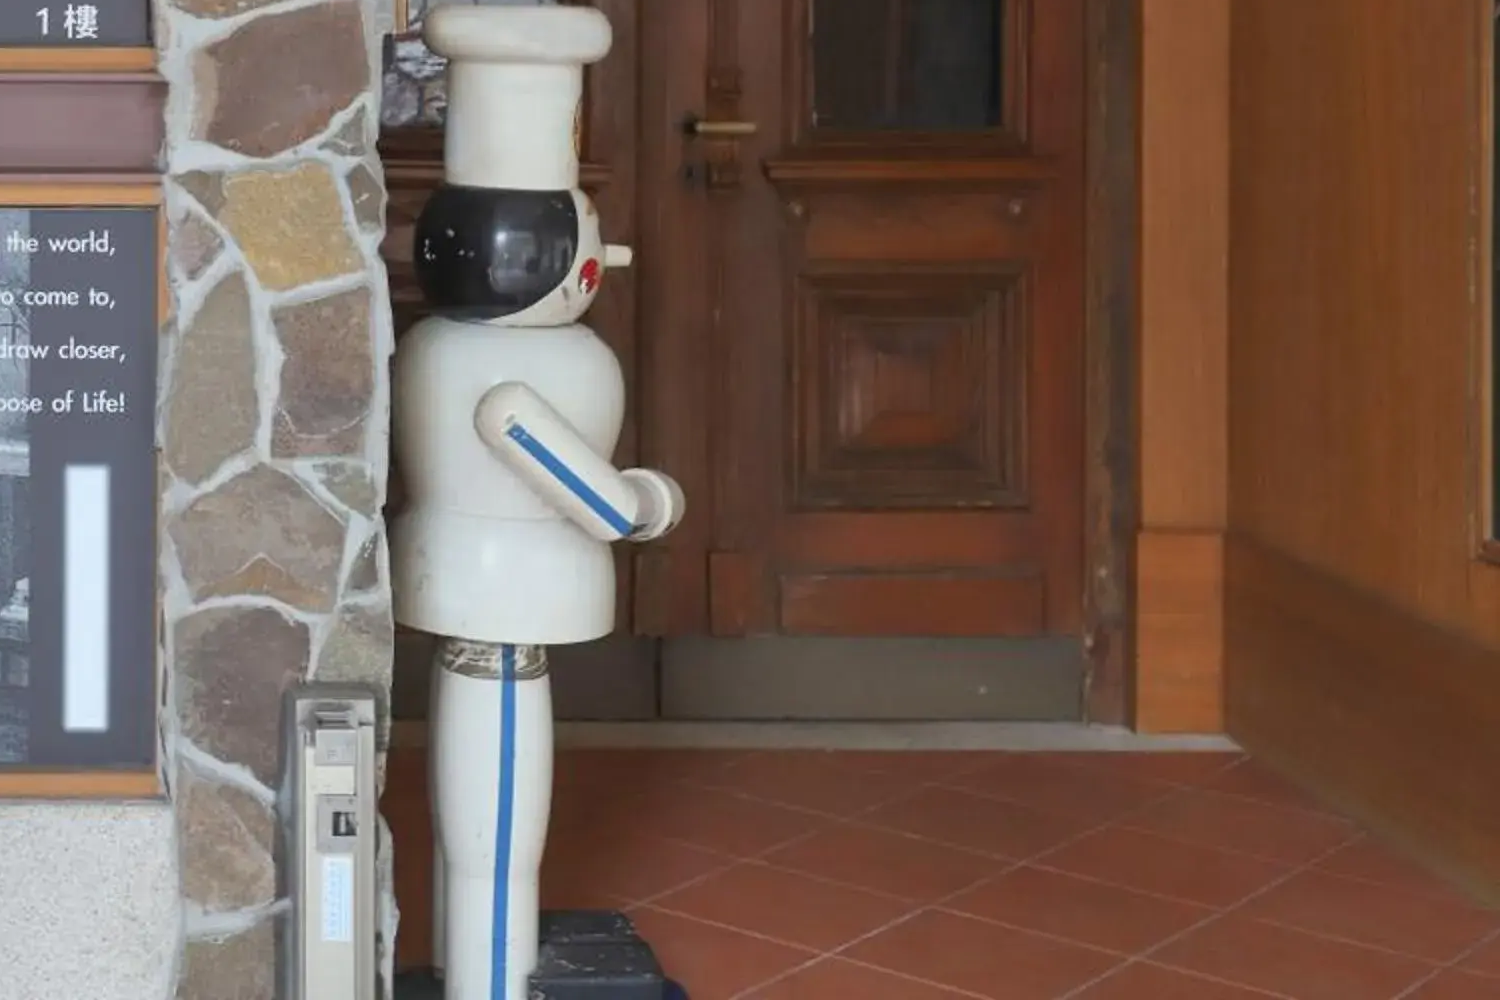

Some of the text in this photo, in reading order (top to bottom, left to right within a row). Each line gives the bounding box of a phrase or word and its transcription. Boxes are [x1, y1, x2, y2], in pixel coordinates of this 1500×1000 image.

[7, 230, 39, 252] the
[48, 230, 116, 257] world,
[23, 289, 79, 306] come
[89, 287, 116, 310] to,
[58, 335, 127, 363] closer,
[51, 390, 74, 412] of
[82, 391, 126, 412] Life!
